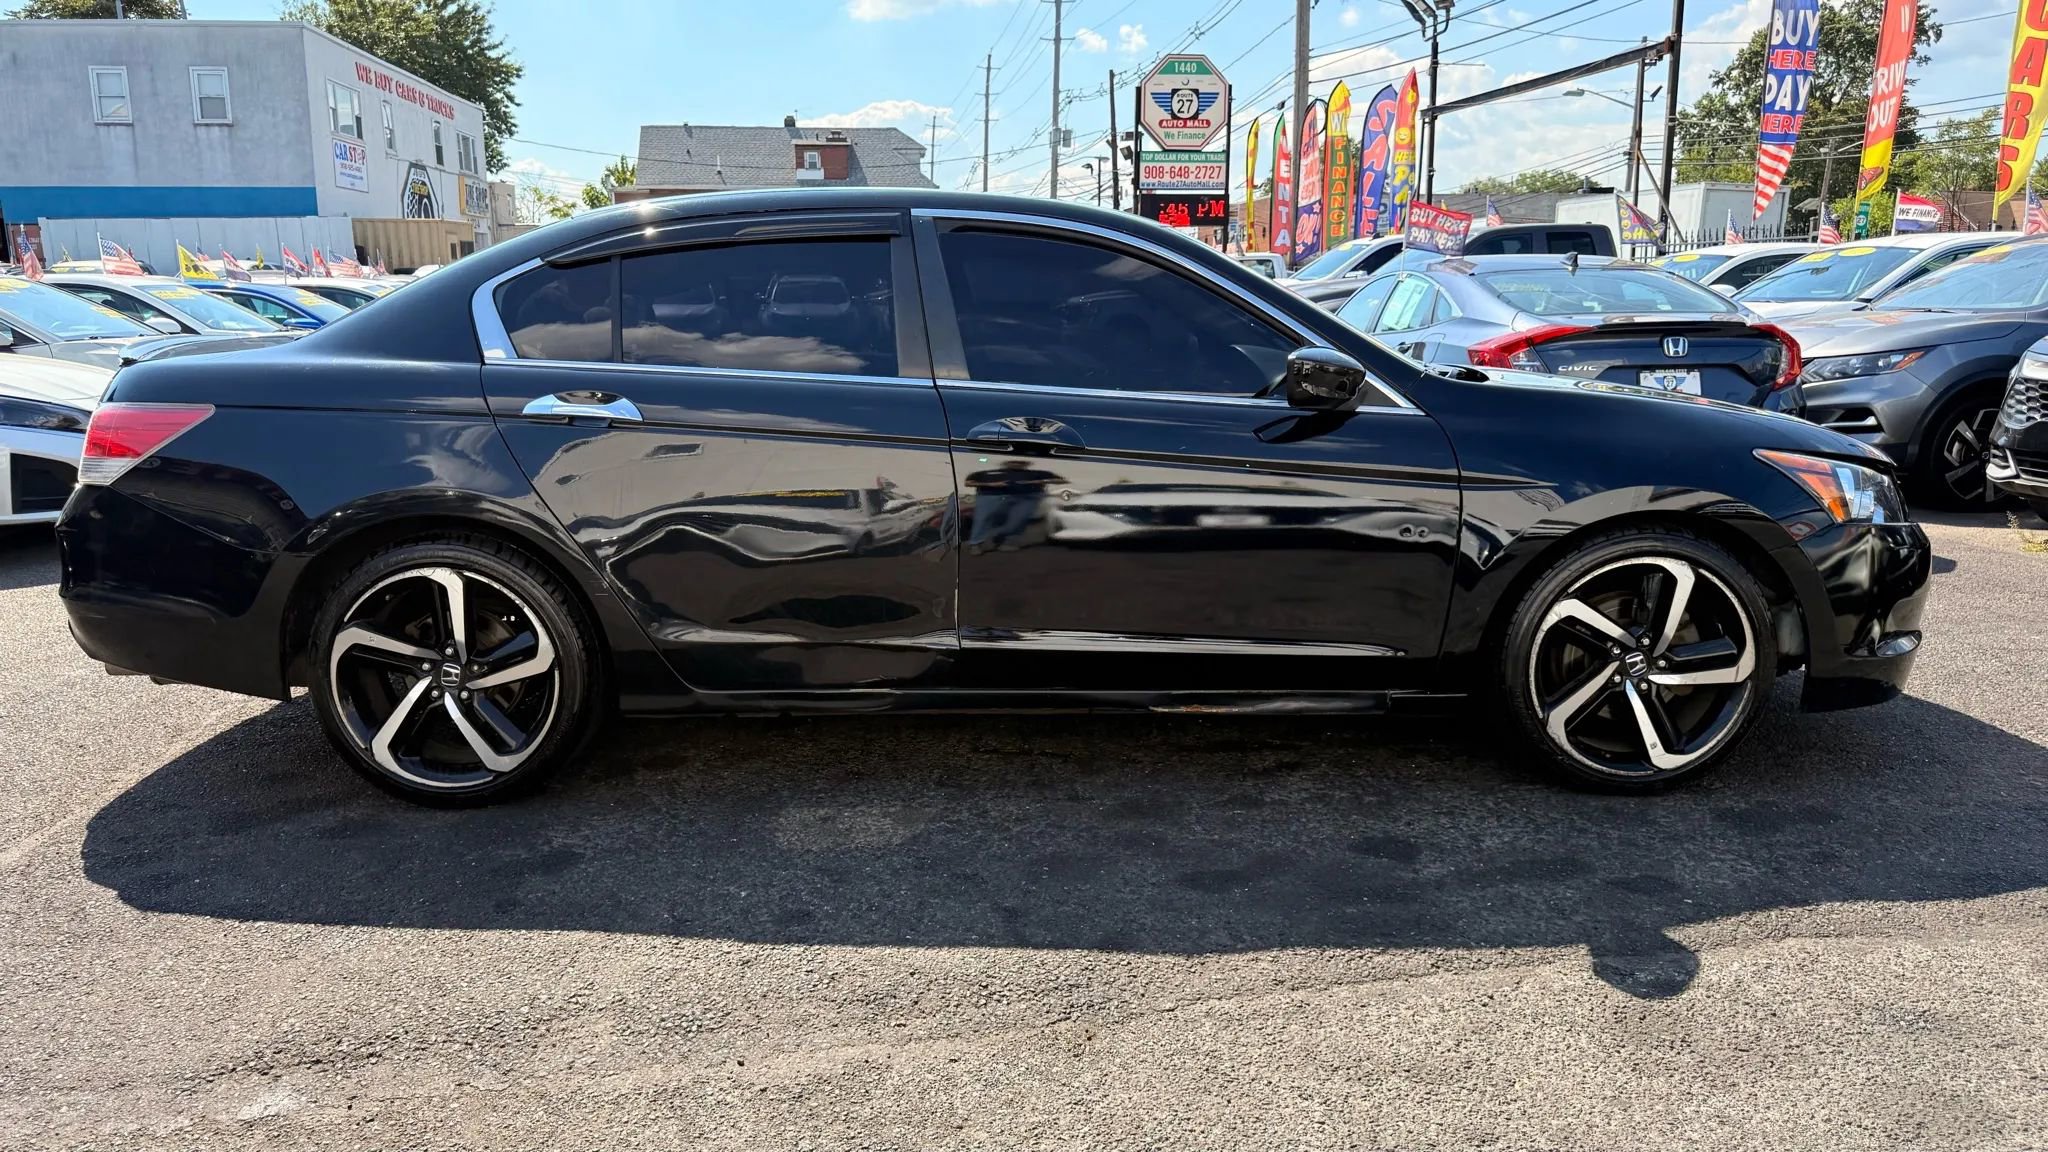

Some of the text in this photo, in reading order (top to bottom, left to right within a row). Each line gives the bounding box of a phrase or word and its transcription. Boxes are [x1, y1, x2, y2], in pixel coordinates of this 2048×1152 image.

[1771, 9, 1820, 46] BUY
[1174, 62, 1197, 73] 1440
[1768, 49, 1818, 71] HERE
[1874, 60, 1907, 96] RIV
[355, 61, 373, 85] WE
[374, 70, 393, 93] BUY
[395, 80, 417, 103] CARS
[425, 93, 455, 120] TRUCKS
[1765, 73, 1813, 112] PAY
[1176, 99, 1193, 114] 27
[1161, 120, 1208, 128] AUTO MALL
[1331, 111, 1348, 136] W
[1164, 131, 1206, 140] We Finance
[334, 141, 349, 161] CAR
[1142, 152, 1154, 161] TOP
[1155, 152, 1177, 161] DOLLAR
[1178, 152, 1189, 161] FOR
[1189, 152, 1206, 161] YOUR
[1144, 165, 1222, 180] 908-648-2727
[1359, 99, 1396, 238] SALE
[1329, 137, 1346, 237] FINANCE
[1196, 200, 1225, 217] PM
[1410, 207, 1470, 232] BUY HERE
[1898, 208, 1938, 219] WE FINANCE
[1410, 227, 1463, 250] PAY HERE
